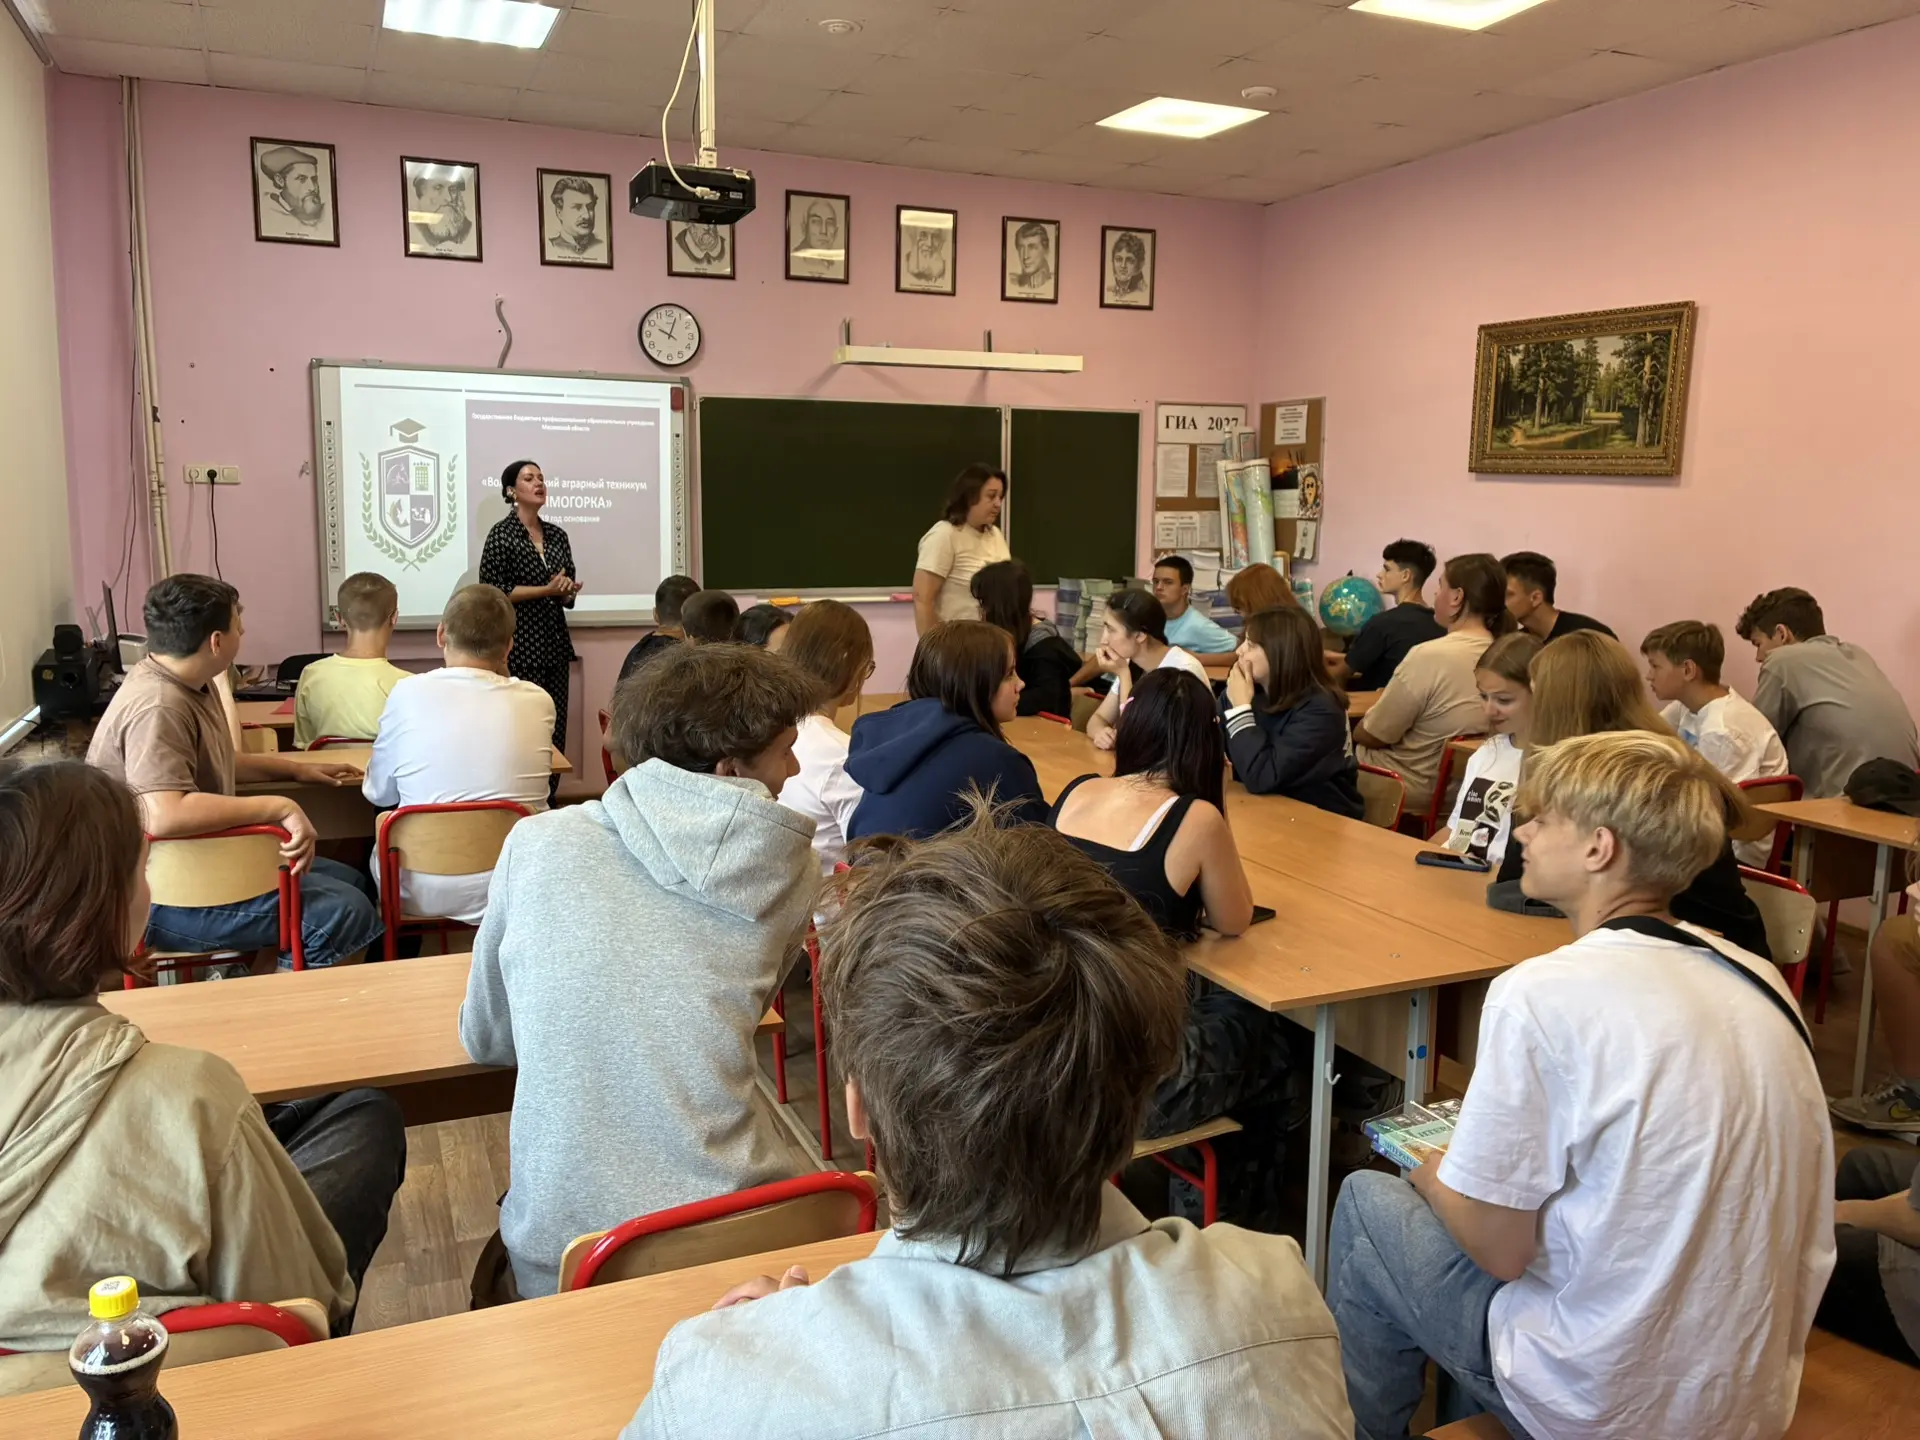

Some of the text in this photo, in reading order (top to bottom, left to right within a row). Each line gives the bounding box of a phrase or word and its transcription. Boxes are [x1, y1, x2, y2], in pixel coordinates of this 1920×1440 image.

[665, 310, 674, 318] 12
[678, 313, 682, 321] 1
[684, 321, 691, 330] 2
[687, 332, 694, 340] 3
[648, 341, 656, 349] 8
[685, 342, 691, 350] 4
[666, 353, 673, 361] 6
[677, 350, 684, 359] 5
[1165, 415, 1198, 430] ГИА
[561, 478, 604, 491] аграрный
[606, 480, 647, 492] техникум
[546, 495, 613, 509] МОГОРКА»
